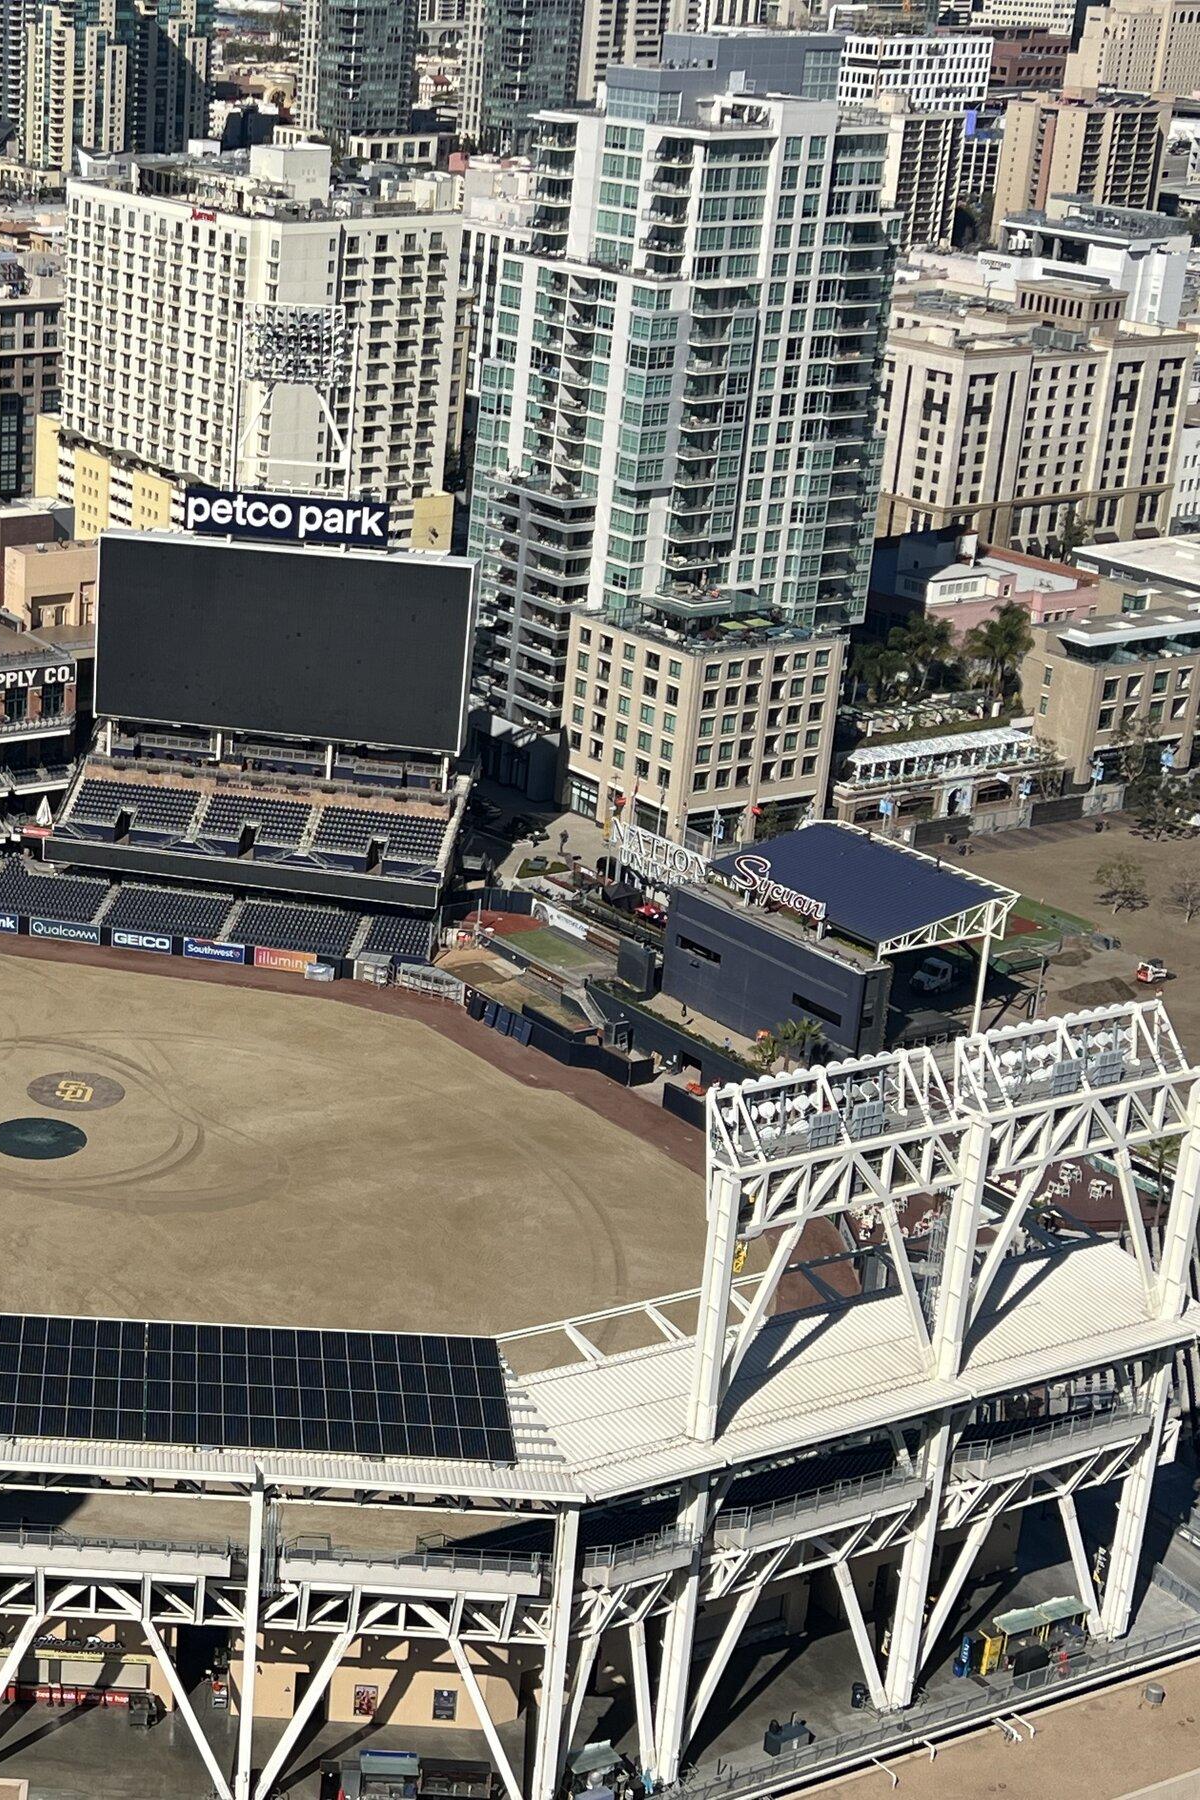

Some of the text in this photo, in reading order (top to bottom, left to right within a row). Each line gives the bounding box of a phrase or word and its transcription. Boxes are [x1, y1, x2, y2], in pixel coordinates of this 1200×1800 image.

[187, 494, 385, 538] petco park
[44, 665, 75, 684] CO.
[732, 854, 827, 920] Sycuan
[32, 921, 98, 941] Qualcomm
[113, 933, 170, 950] GEICO
[187, 943, 234, 958] Southwest
